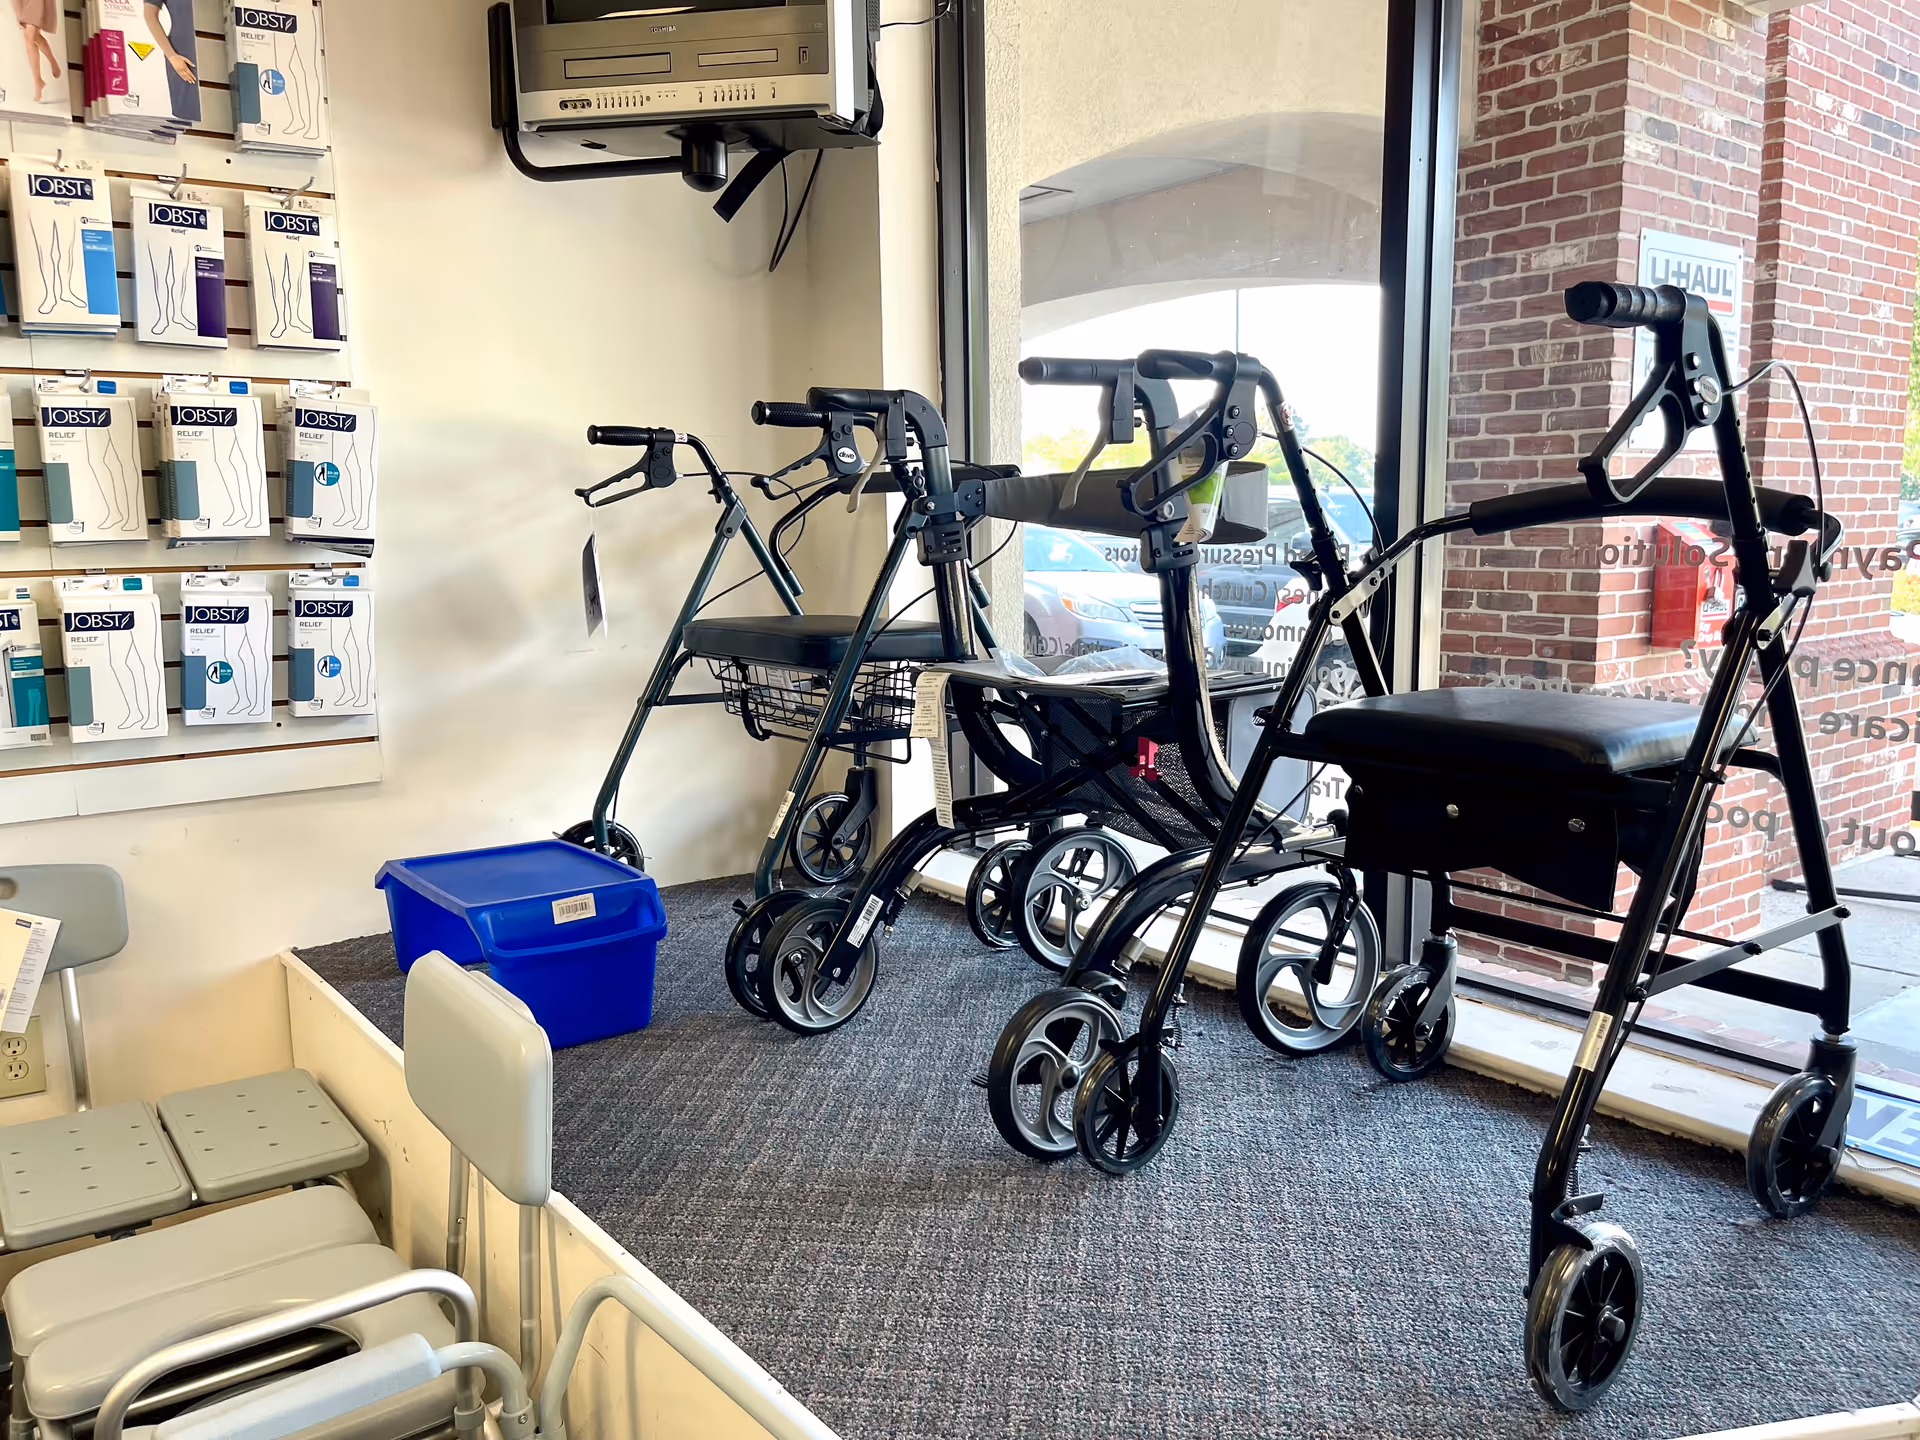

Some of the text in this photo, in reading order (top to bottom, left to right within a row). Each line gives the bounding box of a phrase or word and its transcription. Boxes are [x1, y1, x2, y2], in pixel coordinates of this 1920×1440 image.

[240, 7, 286, 29] JOBST
[241, 32, 265, 41] RELIEF
[650, 25, 677, 33] TOSHIBA
[30, 174, 85, 196] JOBST
[150, 203, 200, 225] JOBST
[266, 211, 313, 232] JOBST
[47, 407, 99, 426] JOBST
[176, 406, 226, 425] JOBST
[299, 409, 346, 428] JOBST
[299, 432, 324, 440] RELIEF
[190, 606, 239, 623] JOBST
[299, 600, 344, 617] JOBST
[70, 612, 123, 632] JOBST
